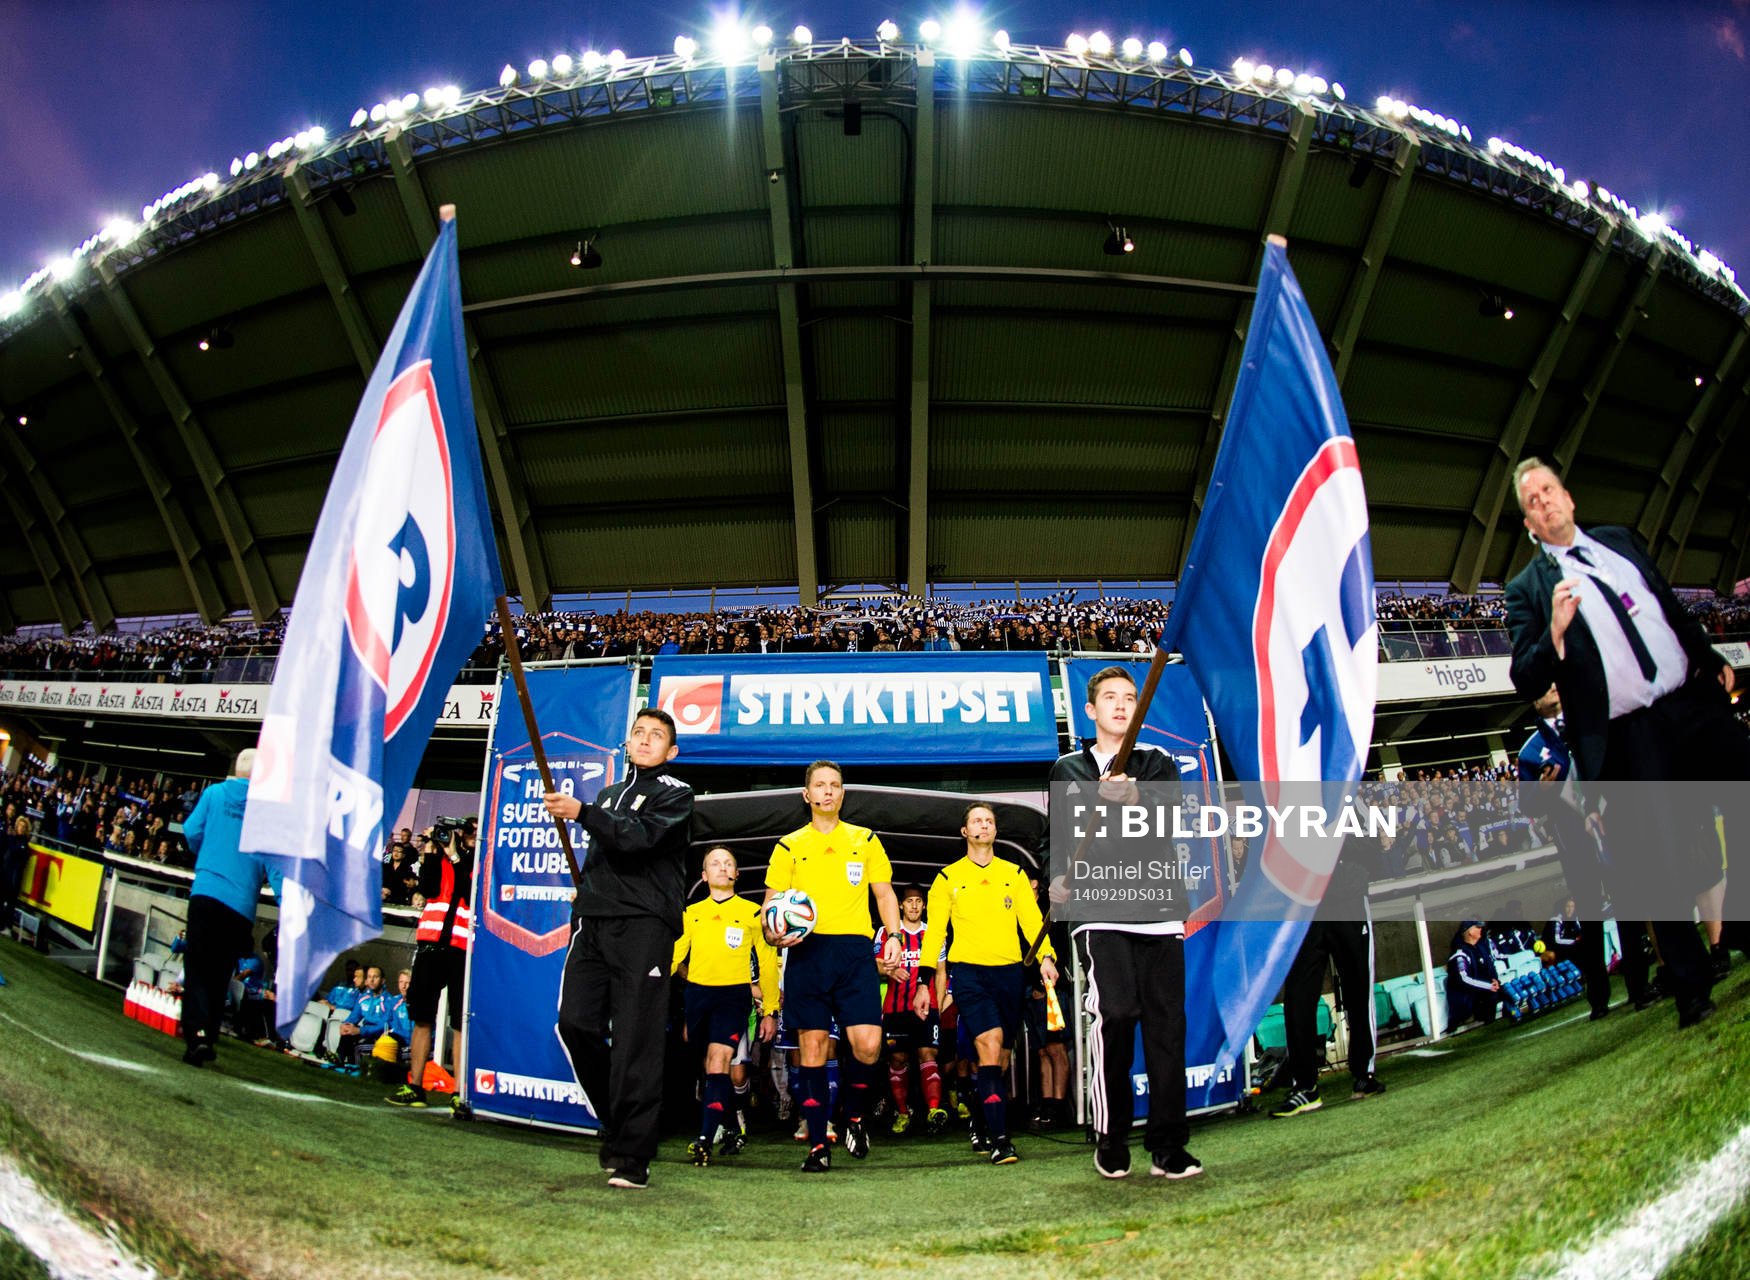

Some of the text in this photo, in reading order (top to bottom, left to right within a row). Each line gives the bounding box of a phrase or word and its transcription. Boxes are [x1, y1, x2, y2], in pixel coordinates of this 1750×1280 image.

[1433, 663, 1487, 691] higab
[66, 693, 93, 706] RASTA
[96, 694, 126, 709] RASTA
[131, 695, 164, 711] RASTA
[169, 696, 207, 713] RASTA
[215, 698, 259, 715] RASTA
[737, 678, 1034, 726] STRYKTIPSET
[497, 827, 592, 849] FOTBOLS
[933, 1025, 939, 1040] 8
[499, 1078, 588, 1105] STRYKTIPSE
